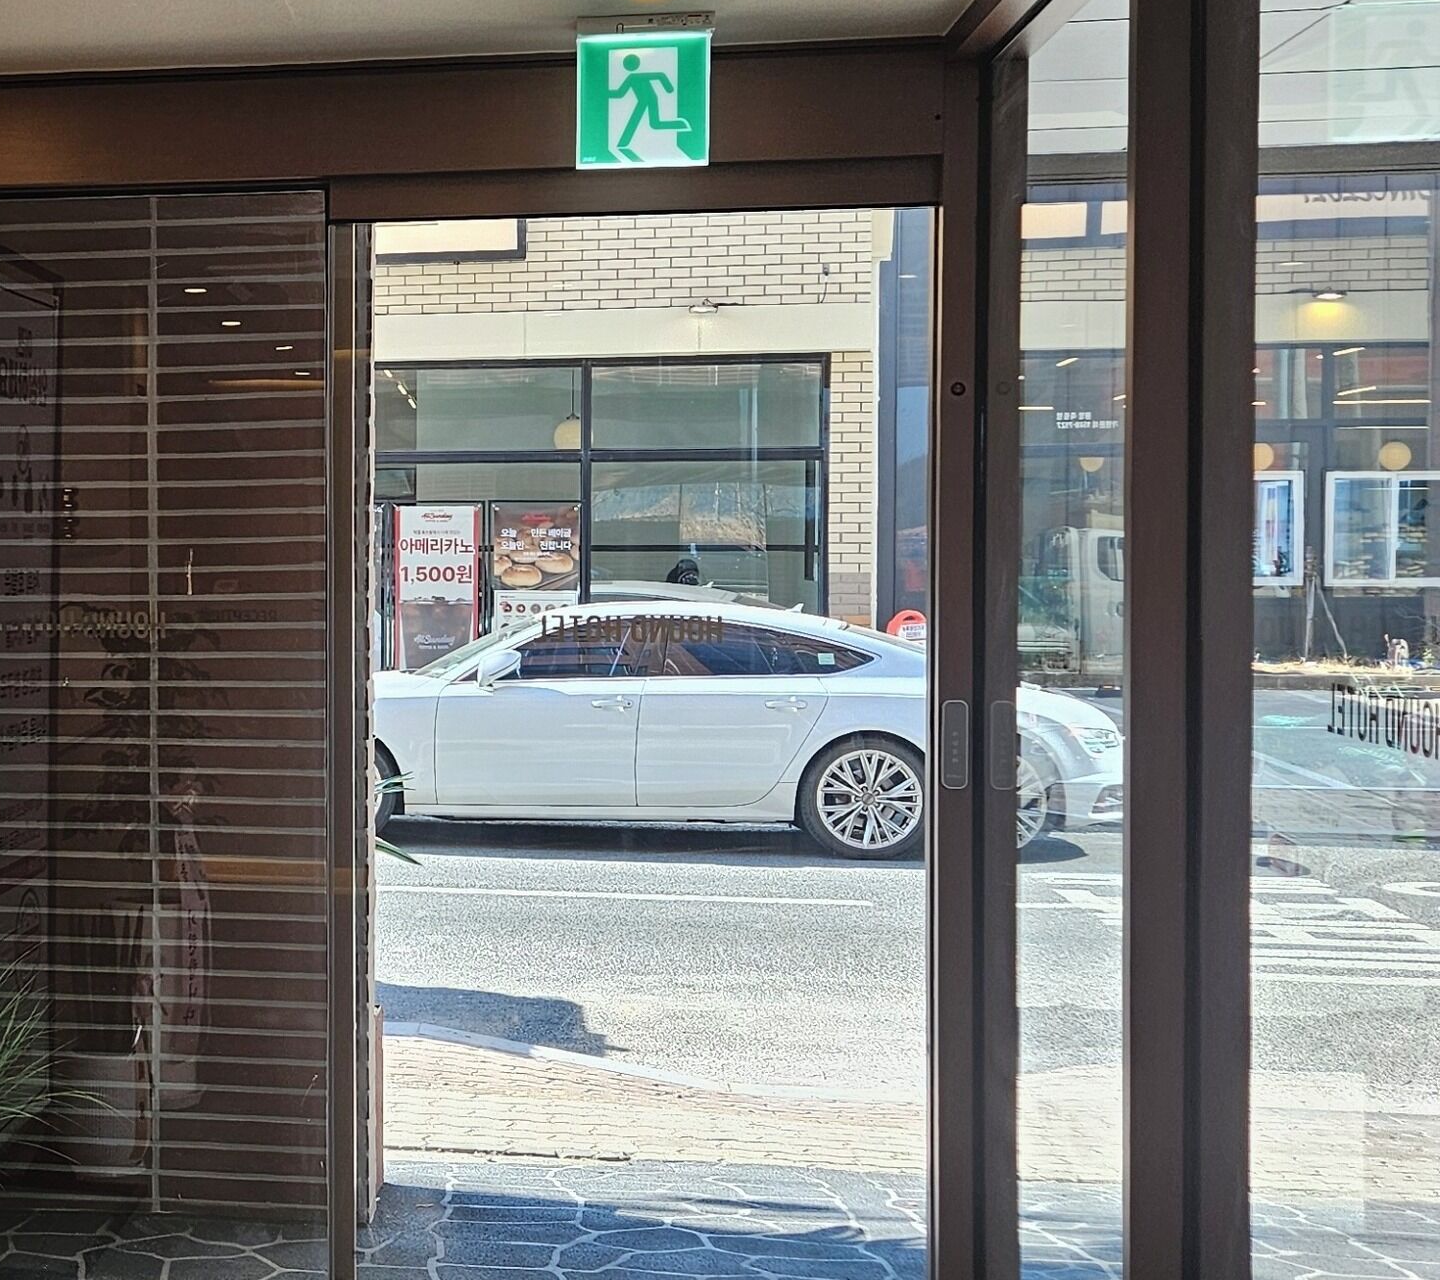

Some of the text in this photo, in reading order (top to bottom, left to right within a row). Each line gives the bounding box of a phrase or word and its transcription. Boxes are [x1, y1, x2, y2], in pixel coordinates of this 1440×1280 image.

[500, 528, 517, 538] 오늘
[548, 528, 572, 538] 베이글
[399, 537, 474, 555] 아메리카노
[500, 540, 525, 551] 오늘만
[400, 564, 473, 585] 1,500원
